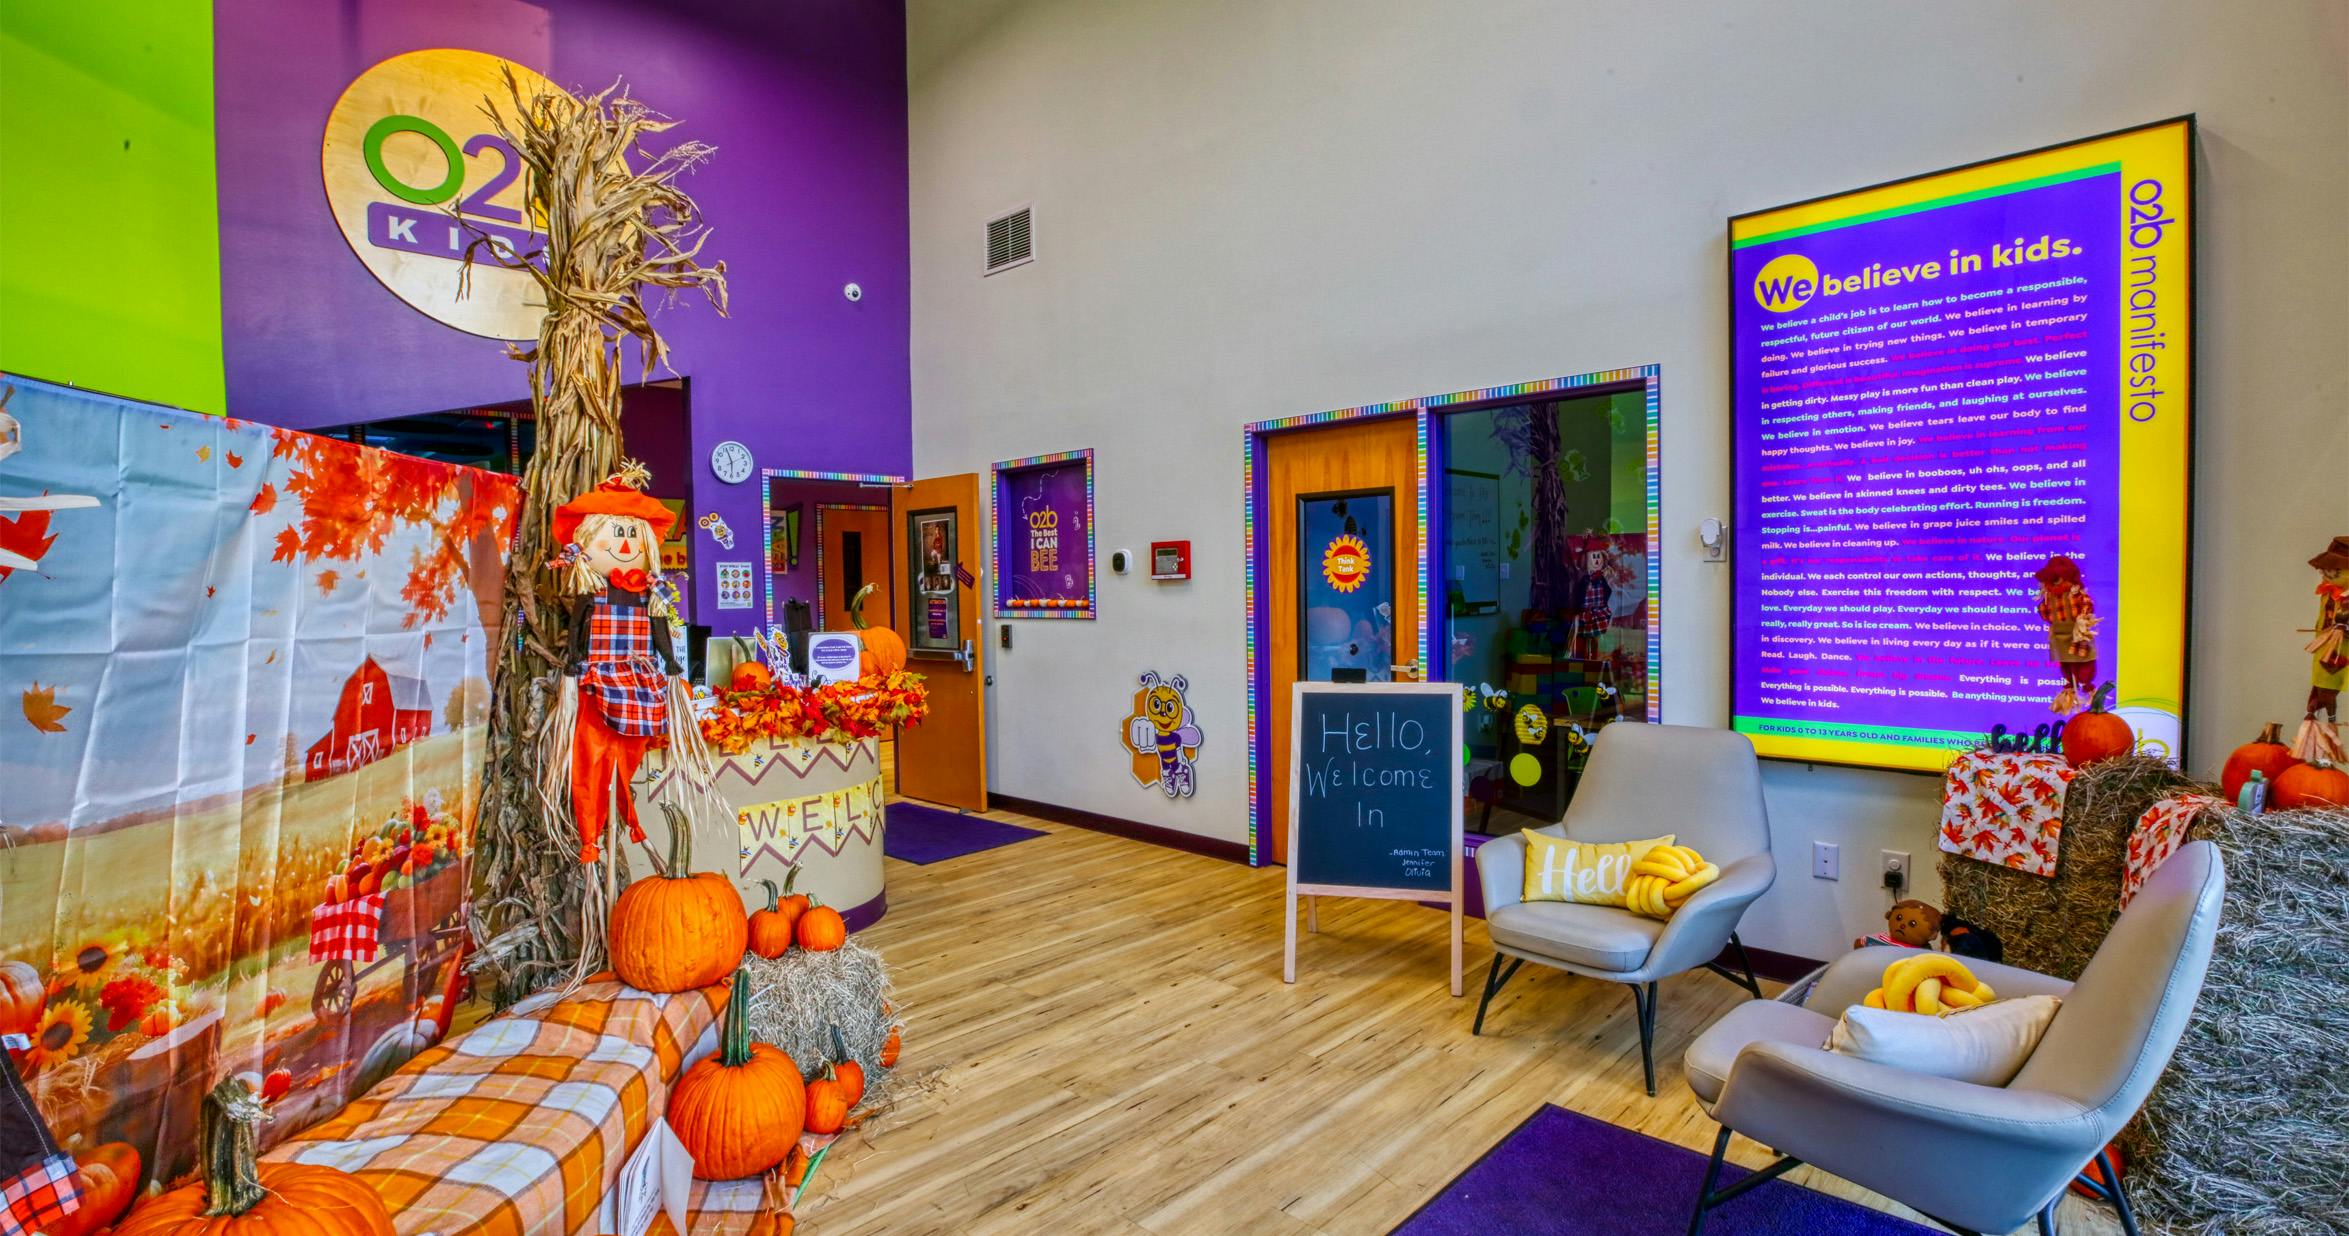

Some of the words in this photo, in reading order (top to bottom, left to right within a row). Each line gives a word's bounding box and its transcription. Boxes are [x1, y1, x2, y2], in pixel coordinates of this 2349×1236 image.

[2129, 179, 2175, 249] o2b
[388, 216, 549, 267] KID
[1759, 275, 1813, 307] We
[1823, 261, 1941, 297] believe
[1950, 249, 1982, 276] in
[1992, 235, 2083, 268] kids.
[1776, 319, 1808, 329] believe
[1849, 308, 1866, 319] job
[1868, 306, 1877, 315] is
[1878, 305, 1890, 313] to
[1892, 302, 1919, 311] learn
[1921, 298, 1943, 307] how
[1945, 295, 1957, 303] to
[1960, 289, 2003, 301] become
[2129, 255, 2165, 422] manifesto
[2025, 354, 2043, 363] We
[2044, 350, 2087, 361] believe
[1761, 401, 1769, 409] in
[1771, 398, 1803, 409] getting
[1830, 393, 1859, 402] Messy
[1859, 390, 1880, 400] play
[1881, 388, 1890, 396] is
[1891, 386, 1918, 395] more
[1919, 384, 1937, 392] fun
[1939, 382, 1963, 390] than
[1965, 378, 1994, 387] clean
[2023, 372, 2042, 381] We
[2044, 368, 2087, 379] believe
[1772, 412, 1819, 424] respecting
[1857, 405, 1893, 415] making
[1938, 398, 1958, 407] and
[1961, 393, 2008, 405] laughing
[2012, 391, 2024, 400] at
[1761, 448, 1788, 456] happy
[1850, 439, 1884, 448] believe
[1886, 437, 1896, 446] in
[1867, 471, 1903, 480] believe
[1905, 469, 1915, 478] in
[1968, 465, 1982, 474] uh
[2045, 460, 2068, 469] and
[2071, 459, 2086, 468] all
[1030, 529, 1043, 537] The
[1043, 528, 1058, 537] Best
[1761, 525, 1800, 534] Stopping
[1872, 521, 1907, 529] believe
[1910, 520, 1919, 528] in
[1922, 521, 1952, 529] grape
[1955, 518, 1980, 528] juice
[1984, 517, 2018, 525] smiles
[2022, 516, 2043, 524] and
[2047, 514, 2085, 525] spilled
[1031, 539, 1034, 550] I
[1036, 538, 1058, 550] CAN
[1798, 539, 1830, 548] believe
[1832, 539, 1841, 547] in
[1842, 538, 1882, 547] cleaning
[1030, 549, 1058, 572] BEE
[1337, 556, 1355, 565] Think
[2005, 551, 2046, 560] believe
[1338, 565, 1354, 573] Tank
[1846, 571, 1881, 579] control
[1761, 588, 1794, 597] Nobody
[1821, 587, 1860, 596] Exercise
[1862, 587, 1881, 596] this
[1884, 587, 1927, 596] freedom
[1931, 587, 1954, 595] with
[1958, 673, 2012, 685] Everything
[2019, 675, 2029, 684] is
[1761, 681, 1801, 691] Everything
[1850, 686, 1896, 696] Everything
[1898, 687, 1905, 695] is
[1951, 690, 1964, 698] Be
[1964, 692, 2006, 702] anything
[1775, 697, 1806, 705] believe
[1807, 698, 1816, 706] in
[1759, 724, 1776, 732] FOR
[1777, 725, 1796, 734] KIDS
[1806, 727, 1817, 735] TO
[1819, 728, 1827, 736] 13
[1829, 729, 1857, 738] YEARS
[1860, 732, 1878, 740] OLD
[1903, 735, 1945, 745] FAMILIES
[1947, 738, 1971, 747] WHO
[1991, 720, 2067, 754] hell
[1306, 757, 1433, 799] Welcome
[1357, 801, 1384, 828] In
[1538, 845, 1632, 900] Hell
